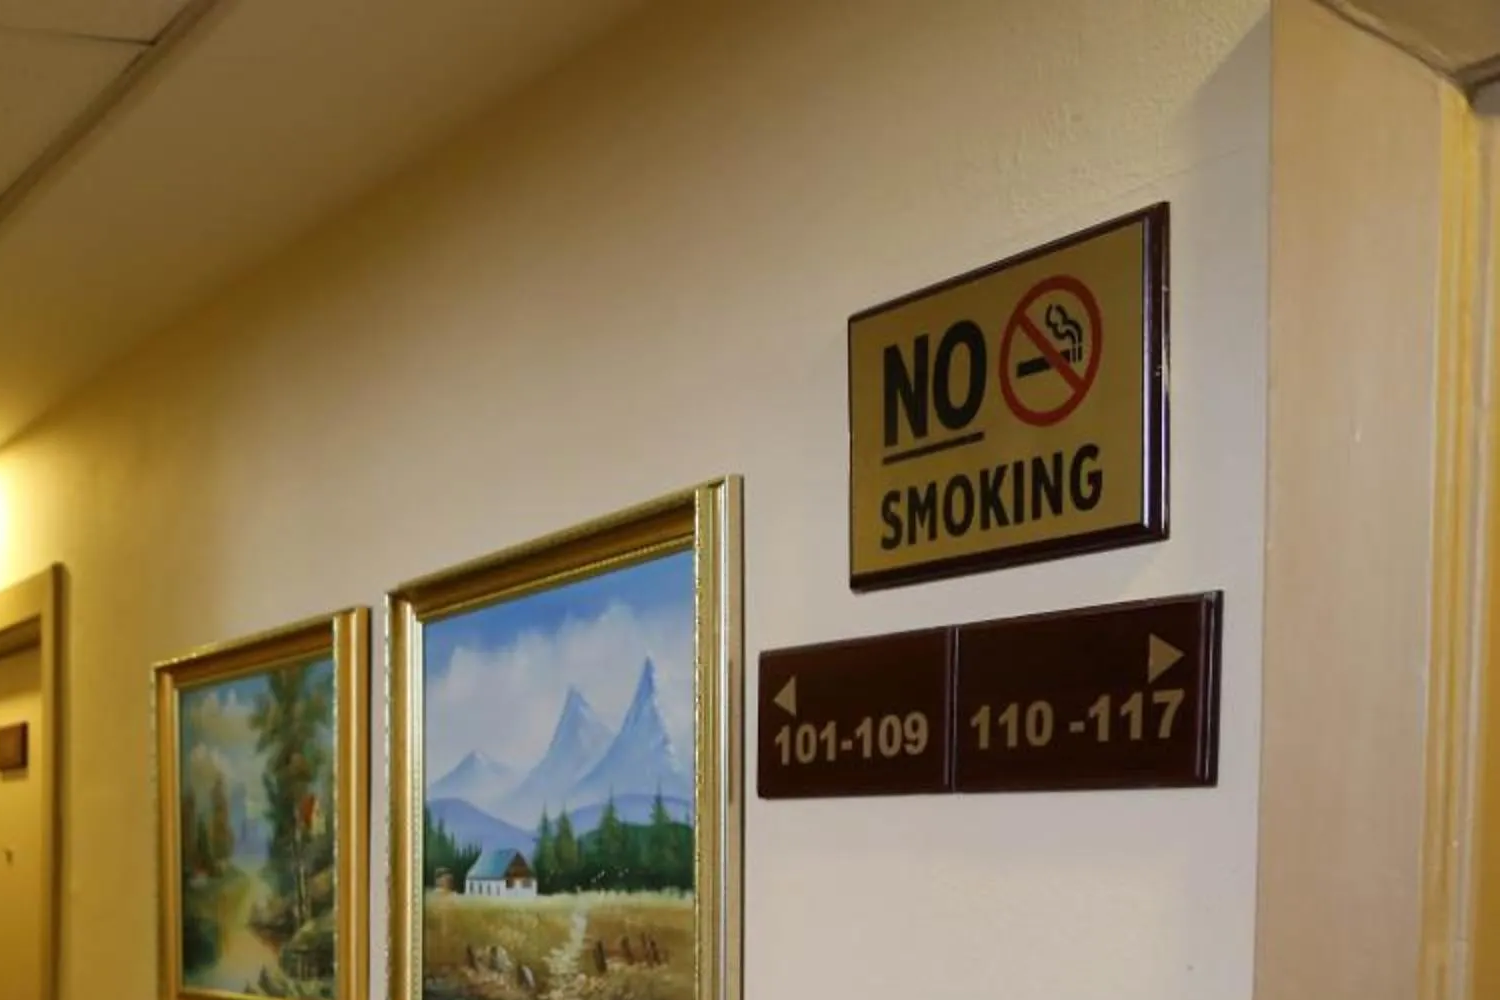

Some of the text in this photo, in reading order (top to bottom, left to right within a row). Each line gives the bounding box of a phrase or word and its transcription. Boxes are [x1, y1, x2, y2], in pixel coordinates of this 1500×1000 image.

[883, 319, 988, 447] NO
[880, 443, 1103, 550] SMOKING
[774, 711, 929, 765] 101-109
